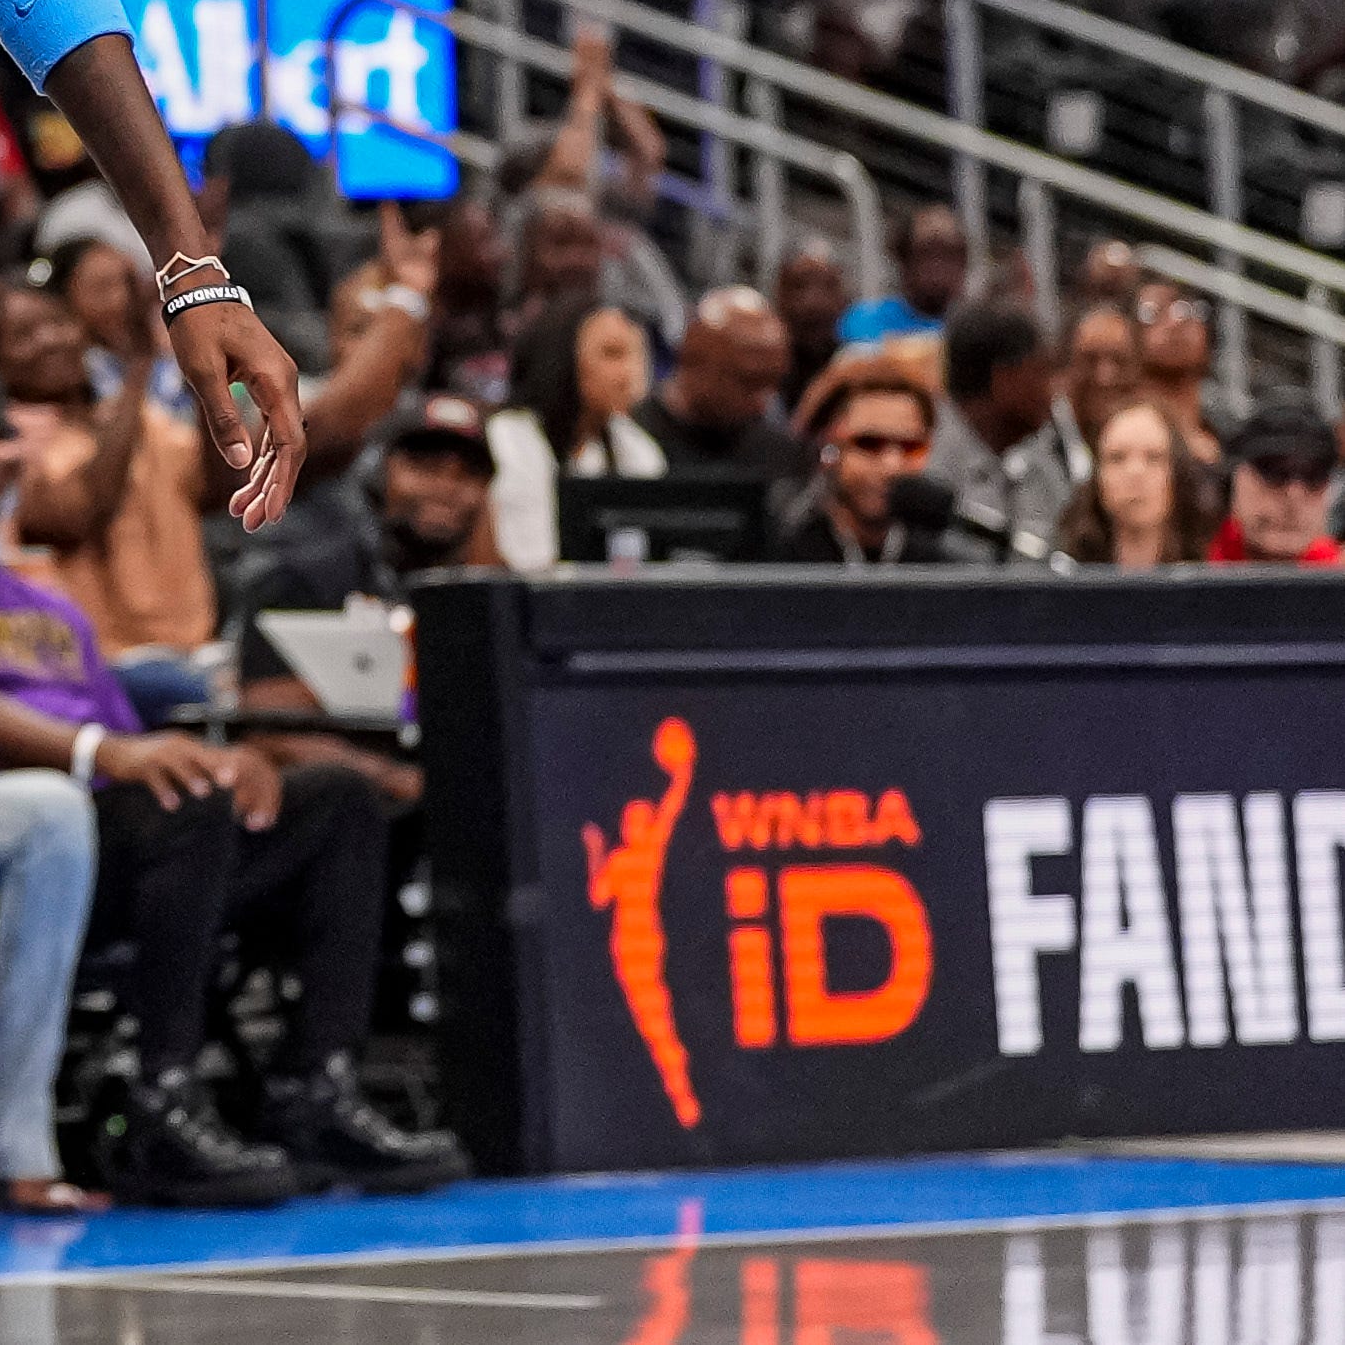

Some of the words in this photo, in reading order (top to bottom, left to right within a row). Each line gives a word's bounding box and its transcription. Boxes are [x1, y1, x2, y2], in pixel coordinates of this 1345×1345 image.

[167, 285, 240, 314] STANDARD
[711, 788, 923, 850] WNBA
[724, 864, 933, 1048] iD
